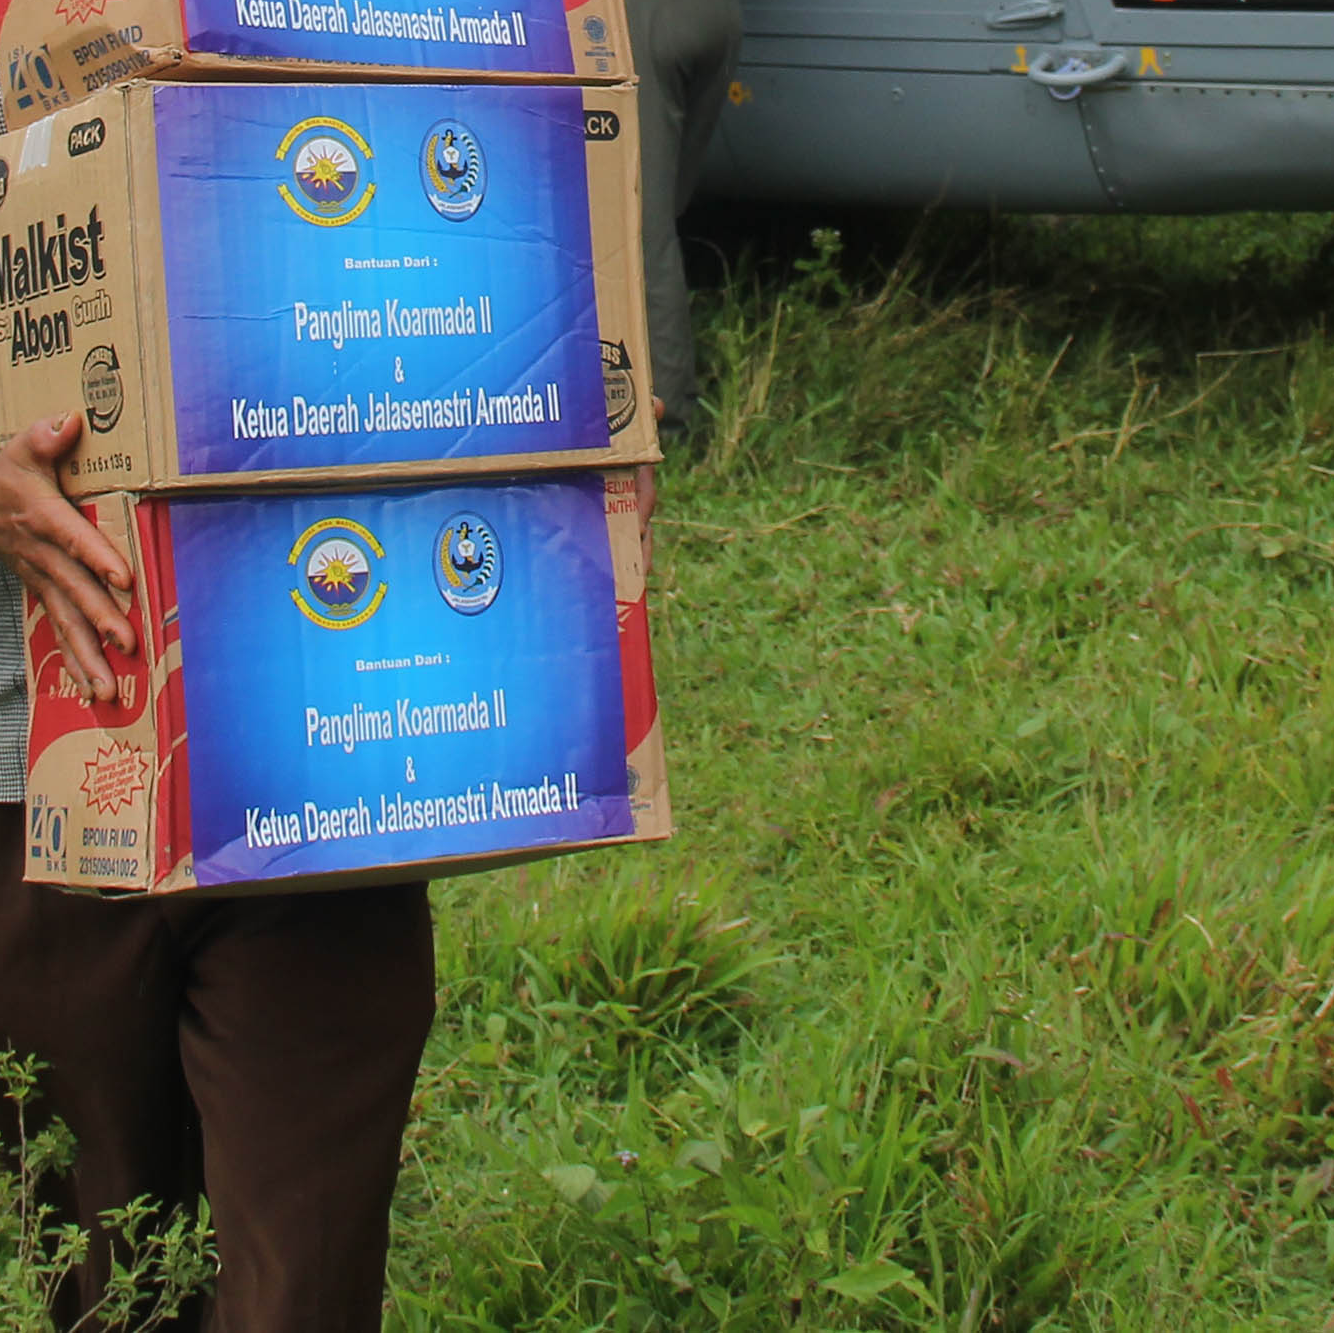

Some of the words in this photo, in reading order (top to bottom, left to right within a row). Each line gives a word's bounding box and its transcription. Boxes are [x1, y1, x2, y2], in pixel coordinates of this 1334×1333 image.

[352, 0, 447, 42] Jalasenastri
[449, 7, 512, 46] Armada
[512, 11, 527, 47] II
[70, 124, 102, 151] PACK
[584, 116, 614, 135] CK
[344, 257, 400, 269] Bantuan
[403, 256, 430, 268] Dari
[12, 307, 72, 366] Abon
[71, 288, 113, 327] Gurih
[293, 300, 381, 350] Panglima
[385, 296, 476, 337] Koarmada
[479, 295, 492, 333] II
[394, 356, 405, 383] &
[231, 398, 289, 439] Ketua
[292, 393, 359, 437] Daerah
[363, 388, 472, 433] Jalasenastri
[475, 384, 544, 426] Armada
[546, 383, 561, 422] II
[355, 657, 411, 672] Bantuan
[414, 653, 442, 667] Dari
[305, 702, 392, 754] Panglima
[396, 691, 489, 737] Koarmada
[493, 688, 507, 728] II
[405, 756, 416, 783] &
[245, 806, 302, 849] Ketua
[304, 796, 371, 843] Daerah
[376, 783, 487, 835] Jalasenastri
[491, 775, 562, 822] Armada
[564, 772, 579, 811] II
[82, 827, 108, 847] BPOM
[121, 828, 138, 847] MD
